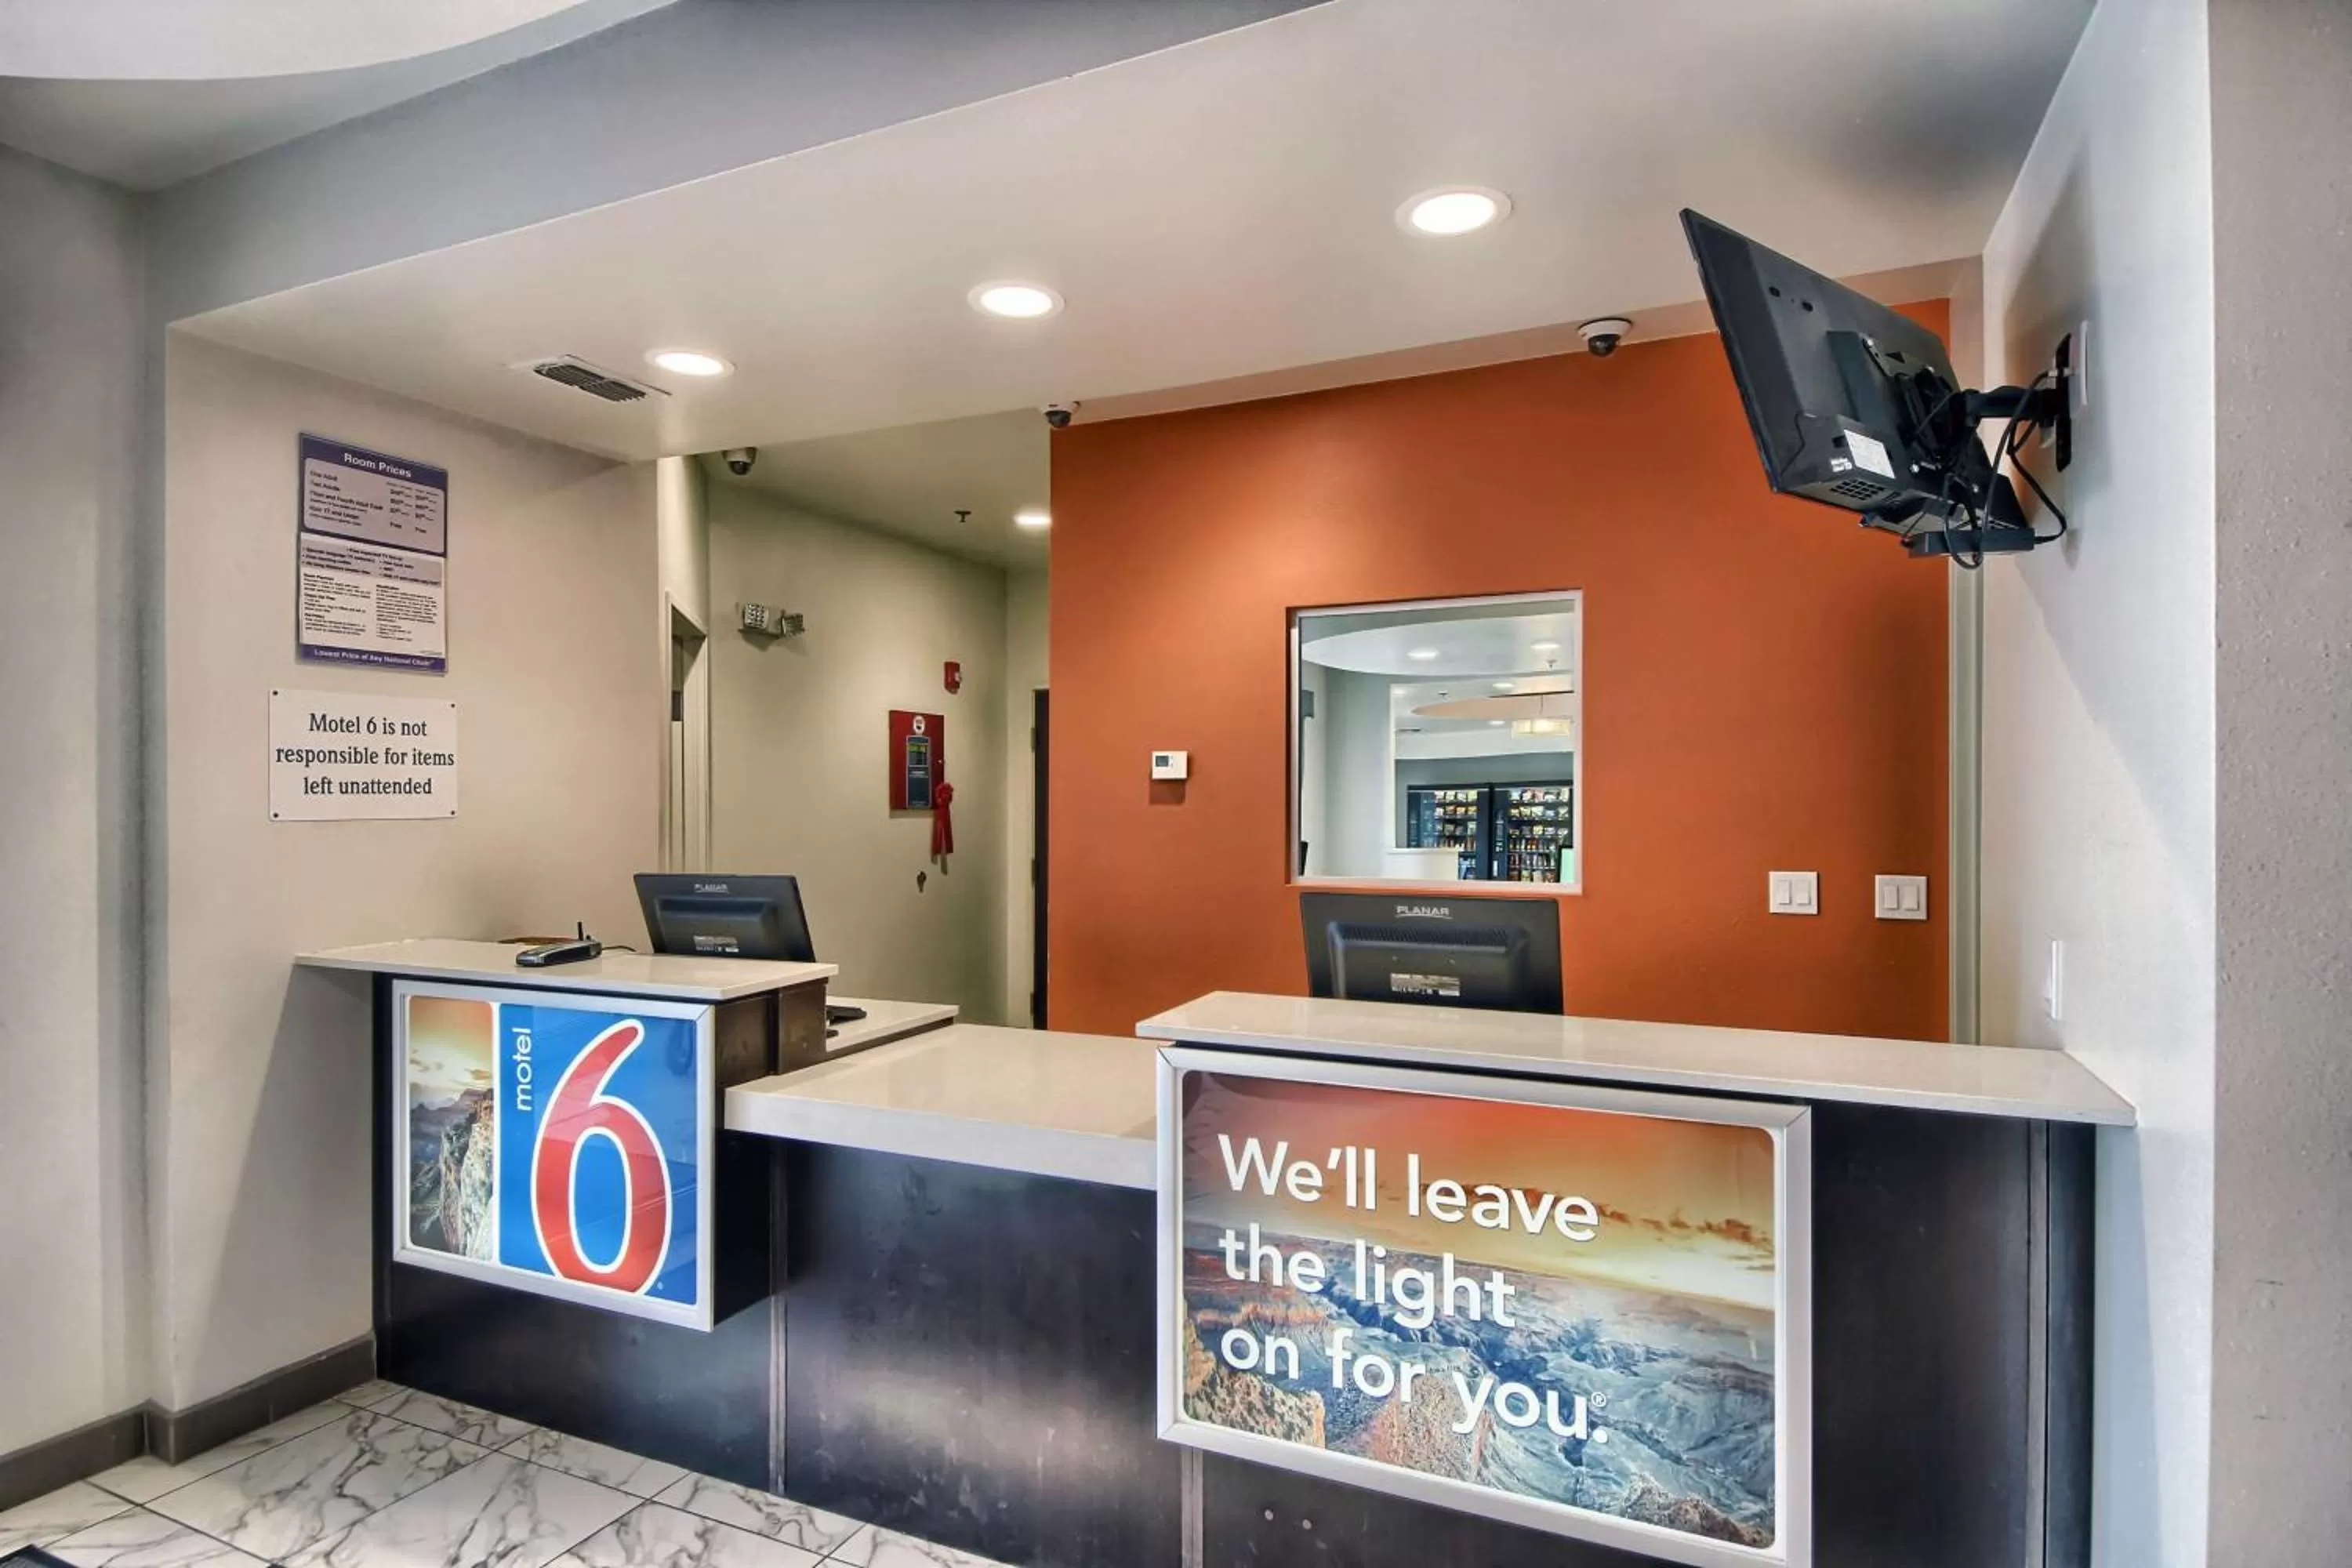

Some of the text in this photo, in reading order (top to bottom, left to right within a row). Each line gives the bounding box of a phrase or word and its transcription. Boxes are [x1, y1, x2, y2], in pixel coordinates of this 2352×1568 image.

[343, 452, 412, 477] Room Prices
[309, 713, 427, 737] Motel 6 is not
[276, 746, 455, 768] responsible for items
[303, 776, 433, 795] left unattended
[1396, 905, 1450, 916] PLANAR
[512, 1019, 673, 1295] motel 6
[1407, 1152, 1600, 1242] leave
[1218, 1222, 1517, 1330] the light
[1221, 1327, 1300, 1381] on
[1325, 1329, 1428, 1403] for
